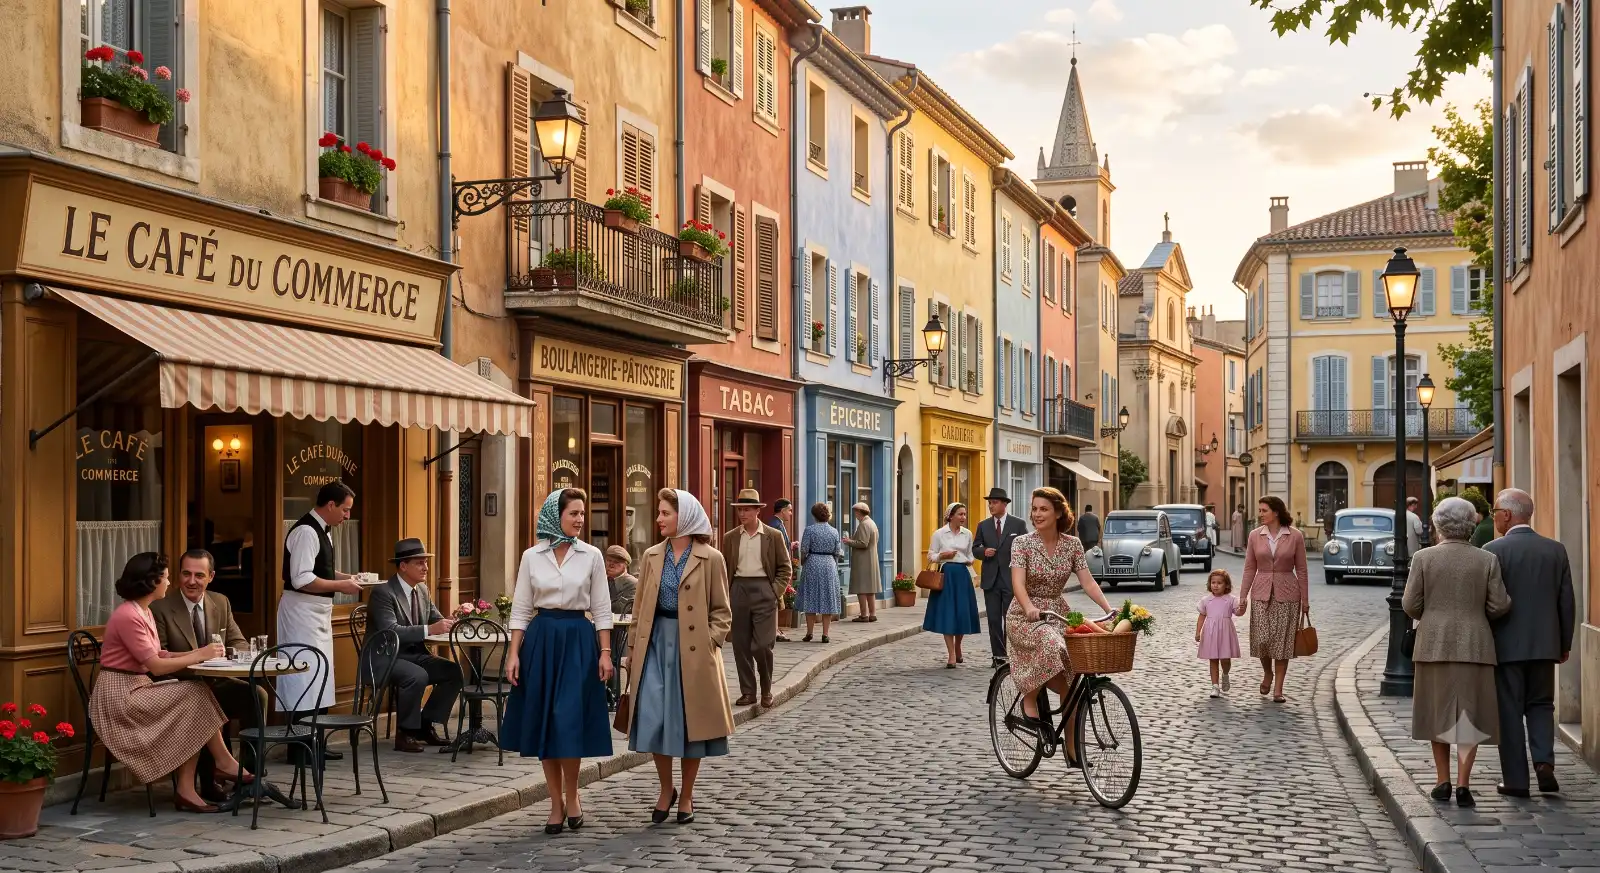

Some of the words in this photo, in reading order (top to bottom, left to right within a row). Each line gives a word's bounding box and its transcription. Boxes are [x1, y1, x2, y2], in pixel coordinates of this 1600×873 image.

[62, 206, 112, 262] LE
[127, 221, 219, 282] CAFÉ
[228, 254, 263, 292] DU
[272, 254, 420, 321] COMMERCE
[541, 345, 675, 391] BOULANGERIE-PÂTISSERIE
[719, 385, 774, 417] TABAC
[830, 401, 881, 432] ÉPICERIE
[100, 430, 149, 461] CAFÉ
[286, 456, 300, 475] LE
[300, 441, 325, 463] CAFÉ
[81, 468, 139, 481] COMMERCE
